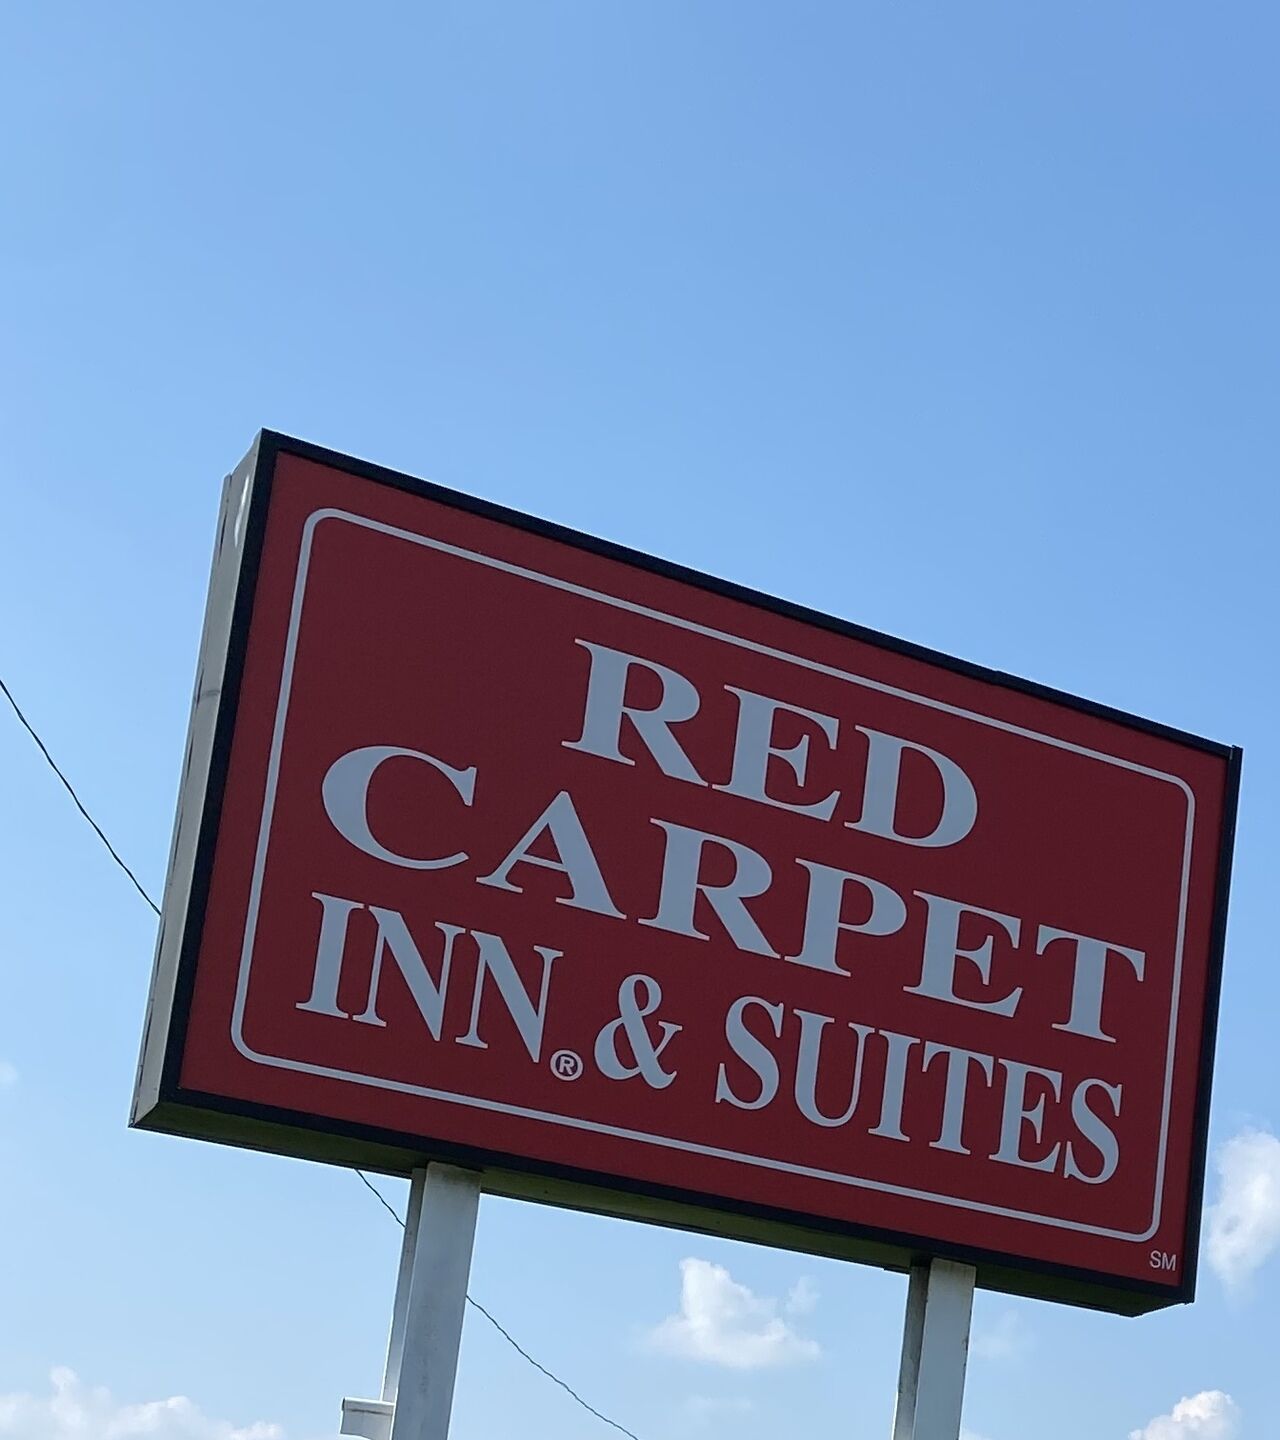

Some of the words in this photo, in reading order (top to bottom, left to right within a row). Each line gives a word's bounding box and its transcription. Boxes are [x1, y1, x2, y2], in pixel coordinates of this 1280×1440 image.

[561, 638, 978, 848] RED
[321, 745, 1146, 1043] CARPET
[594, 974, 683, 1089] &
[715, 996, 1123, 1184] SUITES
[1149, 1250, 1177, 1271] SM
